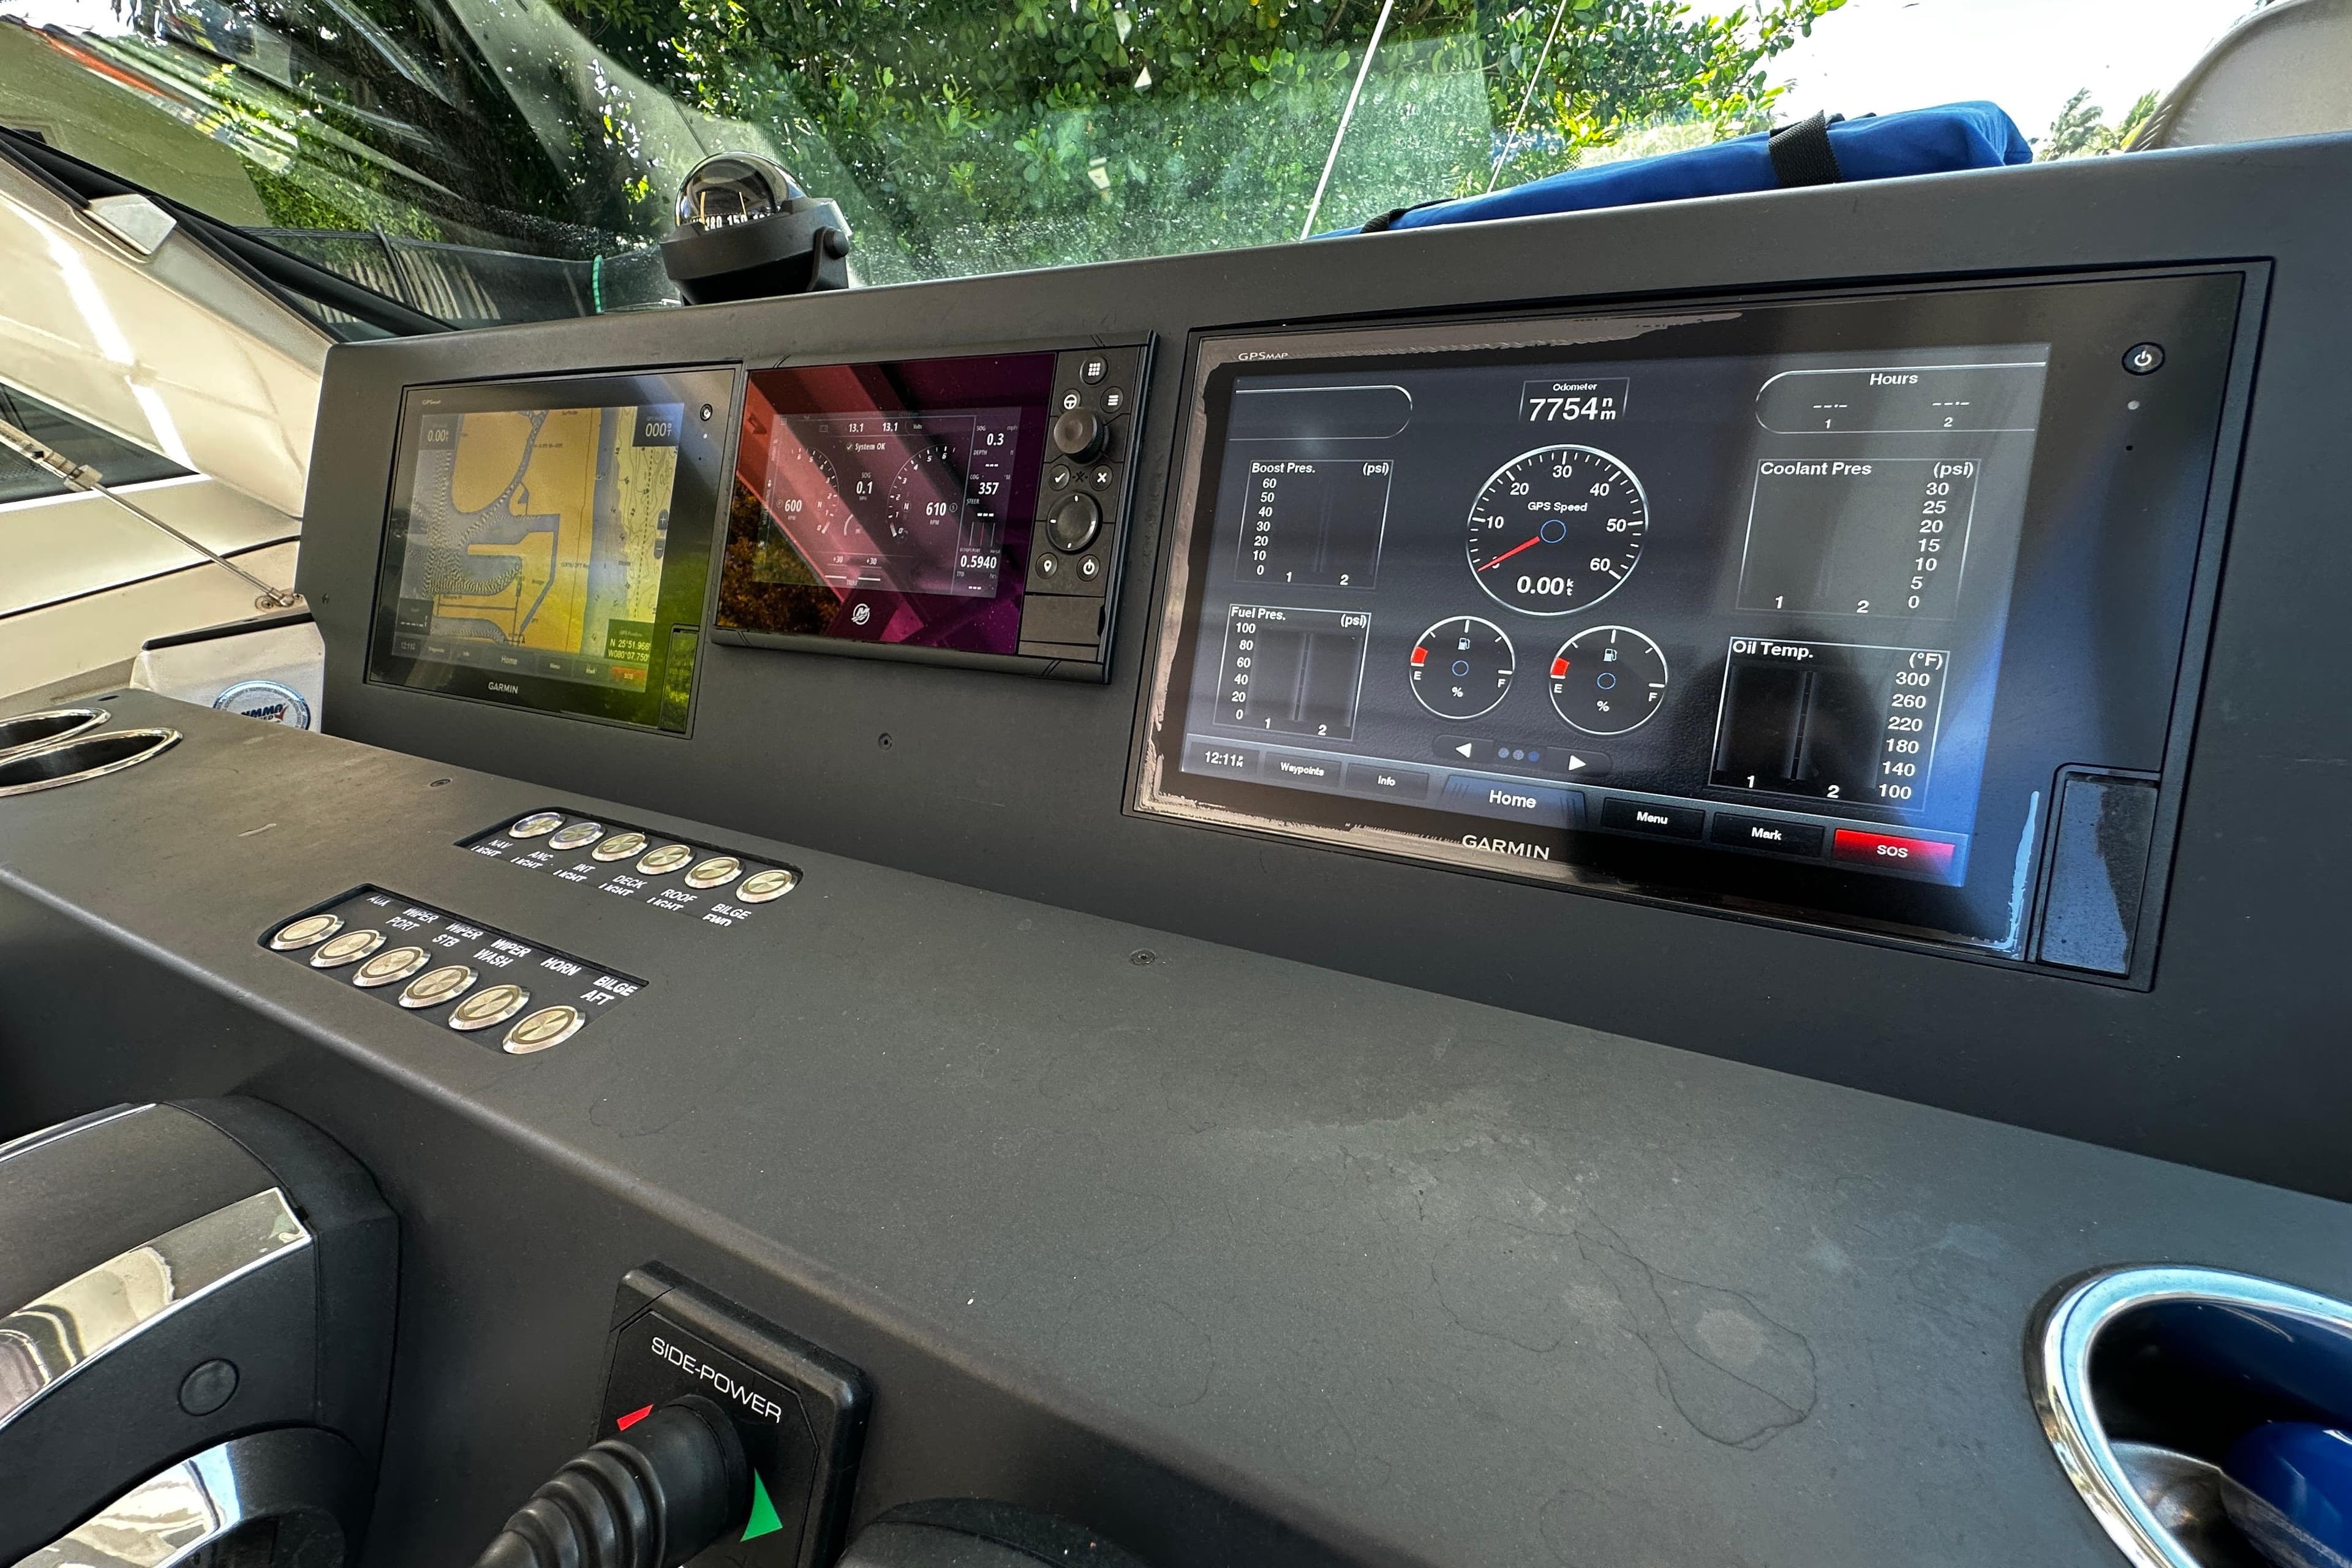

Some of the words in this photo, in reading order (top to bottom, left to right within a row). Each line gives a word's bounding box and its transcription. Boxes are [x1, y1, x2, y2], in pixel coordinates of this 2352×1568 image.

[1869, 373, 1918, 386] Hours
[1553, 383, 1597, 392] Odometer
[1529, 397, 1598, 421] 7754
[849, 423, 864, 432] 13.1
[882, 422, 898, 432] 13.1
[1825, 419, 1832, 429] 1
[1943, 417, 1953, 428] 2
[428, 429, 445, 442] 0.00
[646, 423, 666, 437] 000
[987, 433, 1004, 446] 0.3
[855, 443, 875, 452] System
[1251, 462, 1284, 473] Boost
[1287, 462, 1316, 473] Pres.
[1362, 462, 1389, 476] (psi)
[1553, 465, 1572, 478] 30
[1760, 462, 1828, 475] Coolant
[1831, 462, 1872, 475] Pres
[1932, 462, 1974, 478] (psi)
[856, 481, 873, 494] 0.1
[978, 482, 999, 495] 357
[1262, 478, 1276, 489] 60
[1510, 483, 1529, 496] 20
[1589, 483, 1610, 496] 40
[1926, 483, 1949, 496] 30
[1261, 492, 1275, 502] 50
[785, 499, 802, 512] 600
[926, 502, 946, 516] 610
[1258, 507, 1273, 517] 40
[1528, 502, 1551, 511] GPS
[1553, 502, 1588, 513] Speed
[1922, 500, 1947, 514] 25
[1256, 521, 1270, 532] 30
[1487, 516, 1504, 529] 10
[1606, 518, 1627, 532] 50
[1919, 519, 1943, 533] 20
[1254, 536, 1268, 546] 20
[1918, 538, 1940, 552] 15
[960, 555, 997, 569] 0.5940
[1253, 551, 1267, 561] 10
[1257, 565, 1264, 575] 0
[1589, 558, 1610, 571] 60
[1915, 557, 1938, 571] 10
[1286, 571, 1292, 582] 1
[1340, 575, 1349, 586] 2
[1910, 576, 1923, 589] 5
[1517, 576, 1564, 595] 0.00
[1775, 596, 1783, 609] 1
[1856, 600, 1869, 613] 2
[1908, 595, 1920, 608] 0
[1231, 606, 1255, 618] Fuel
[1257, 608, 1286, 620] Pres.
[1236, 622, 1256, 633] 100
[1340, 614, 1366, 628] (psi)
[610, 638, 616, 647] N
[1239, 640, 1253, 650] 80
[1732, 641, 1756, 655] Oil
[1760, 642, 1814, 660] Temp.
[501, 655, 518, 665] Home
[1237, 657, 1251, 668] 60
[1909, 652, 1943, 670] (°F)
[1234, 674, 1248, 685] 40
[1414, 671, 1422, 680] E
[1895, 672, 1931, 687] 300
[488, 682, 518, 694] GARMIN
[1498, 679, 1506, 688] F
[1553, 684, 1562, 693] E
[1231, 691, 1246, 703] 20
[1452, 687, 1463, 698] %
[1648, 692, 1657, 702] F
[1596, 701, 1610, 712] %
[1891, 695, 1926, 709] 260
[1235, 709, 1243, 720] 0
[1265, 718, 1271, 729] 1
[1318, 724, 1327, 736] 2
[1888, 717, 1923, 732] 220
[1886, 739, 1920, 754] 180
[1205, 751, 1236, 766] 12:11
[1280, 762, 1325, 777] Waypoints
[1882, 761, 1916, 777] 140
[1378, 775, 1396, 786] Info
[1747, 775, 1755, 788] 1
[1827, 785, 1840, 799] 2
[1879, 784, 1912, 800] 100
[1488, 790, 1537, 809] Home
[1637, 811, 1668, 825] Menu
[1751, 827, 1782, 842] Mark
[488, 840, 513, 849] NAV
[1462, 835, 1550, 860] GARMIN
[1877, 844, 1909, 858] SOS
[527, 851, 553, 861] ANC
[573, 864, 596, 873] INT
[612, 875, 647, 889] DECK
[366, 895, 392, 907] AUX
[660, 889, 697, 903] ROOF
[402, 907, 440, 923] WIPER
[710, 903, 752, 920] BILGE
[385, 916, 420, 931] PORT
[445, 922, 483, 940] WIPER
[432, 933, 460, 947] STB
[491, 938, 532, 957] WIPER
[473, 949, 514, 967] WASH
[540, 957, 582, 976] HORN
[593, 976, 638, 997] BILGE
[580, 990, 615, 1005] AFT
[650, 1336, 782, 1424] SIDE-POWER
